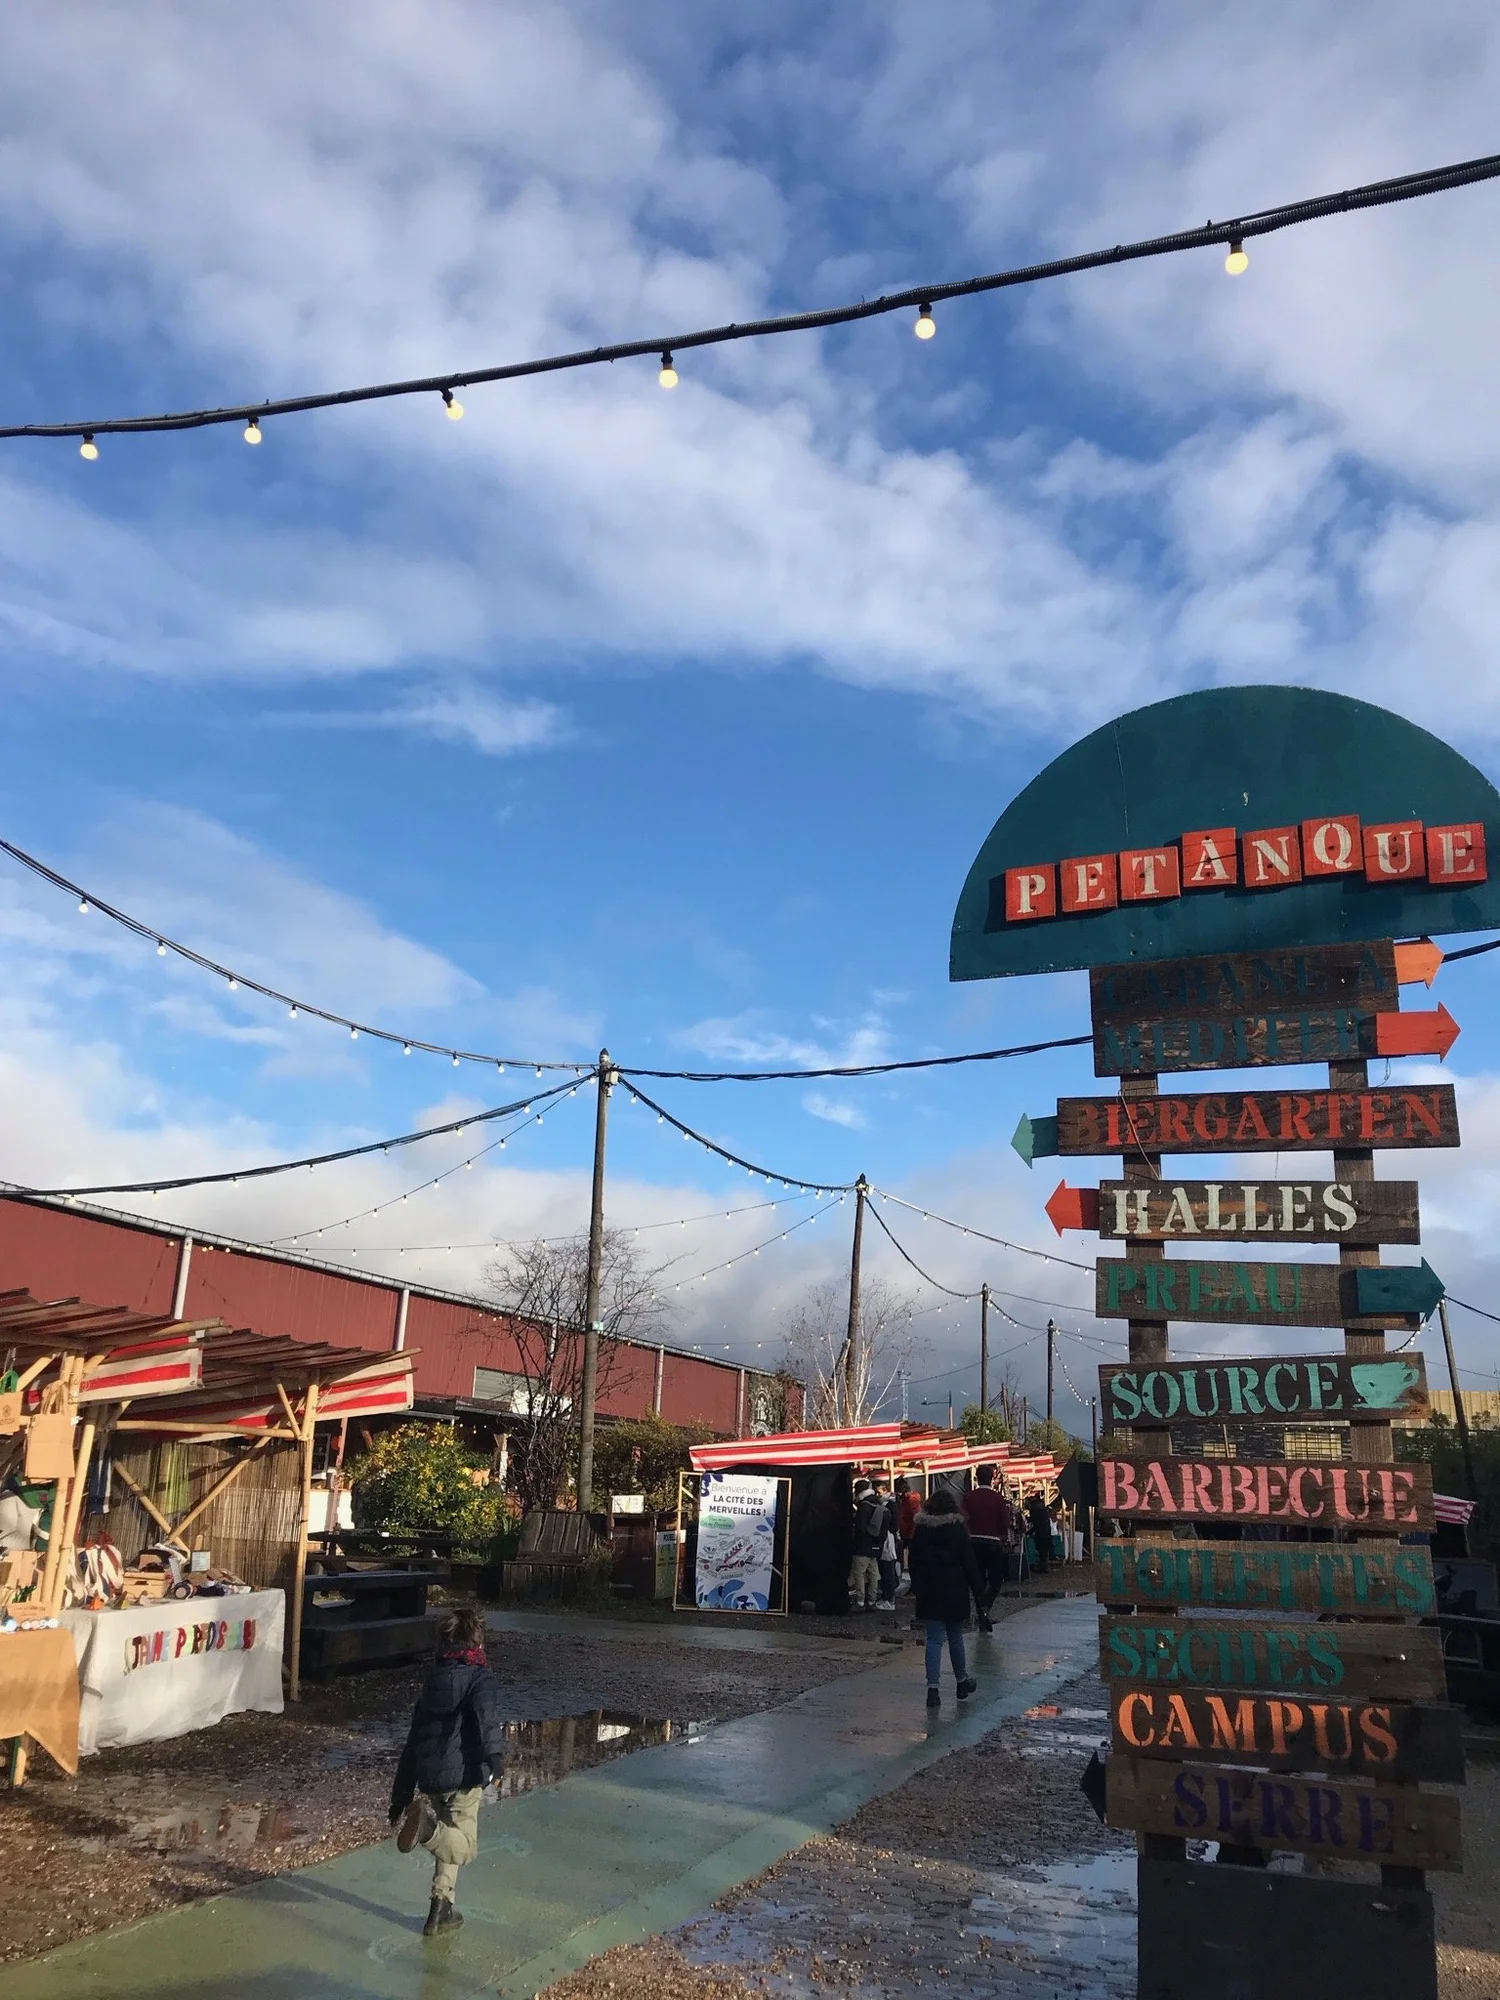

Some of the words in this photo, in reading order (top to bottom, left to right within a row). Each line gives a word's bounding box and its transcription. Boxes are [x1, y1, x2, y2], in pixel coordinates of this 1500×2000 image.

[1017, 821, 1475, 914] PETANQUE
[1069, 1093, 1443, 1148] BIERGARTEN
[1111, 1183, 1359, 1235] HALLES
[1105, 1264, 1302, 1314] PREAU
[1110, 1362, 1345, 1421] SOURCE
[709, 1505, 761, 1517] MERVEILLES
[711, 1482, 760, 1495] Bienvenue
[713, 1495, 724, 1503] LA
[725, 1495, 745, 1504] CITÉ
[746, 1497, 764, 1505] DES
[1101, 1461, 1419, 1523] BARBECUE
[1101, 1545, 1435, 1613] TOILETTES
[1107, 1627, 1346, 1688] SECHES
[1118, 1692, 1399, 1763] CAMPUS
[1173, 1772, 1395, 1854] SERRE
